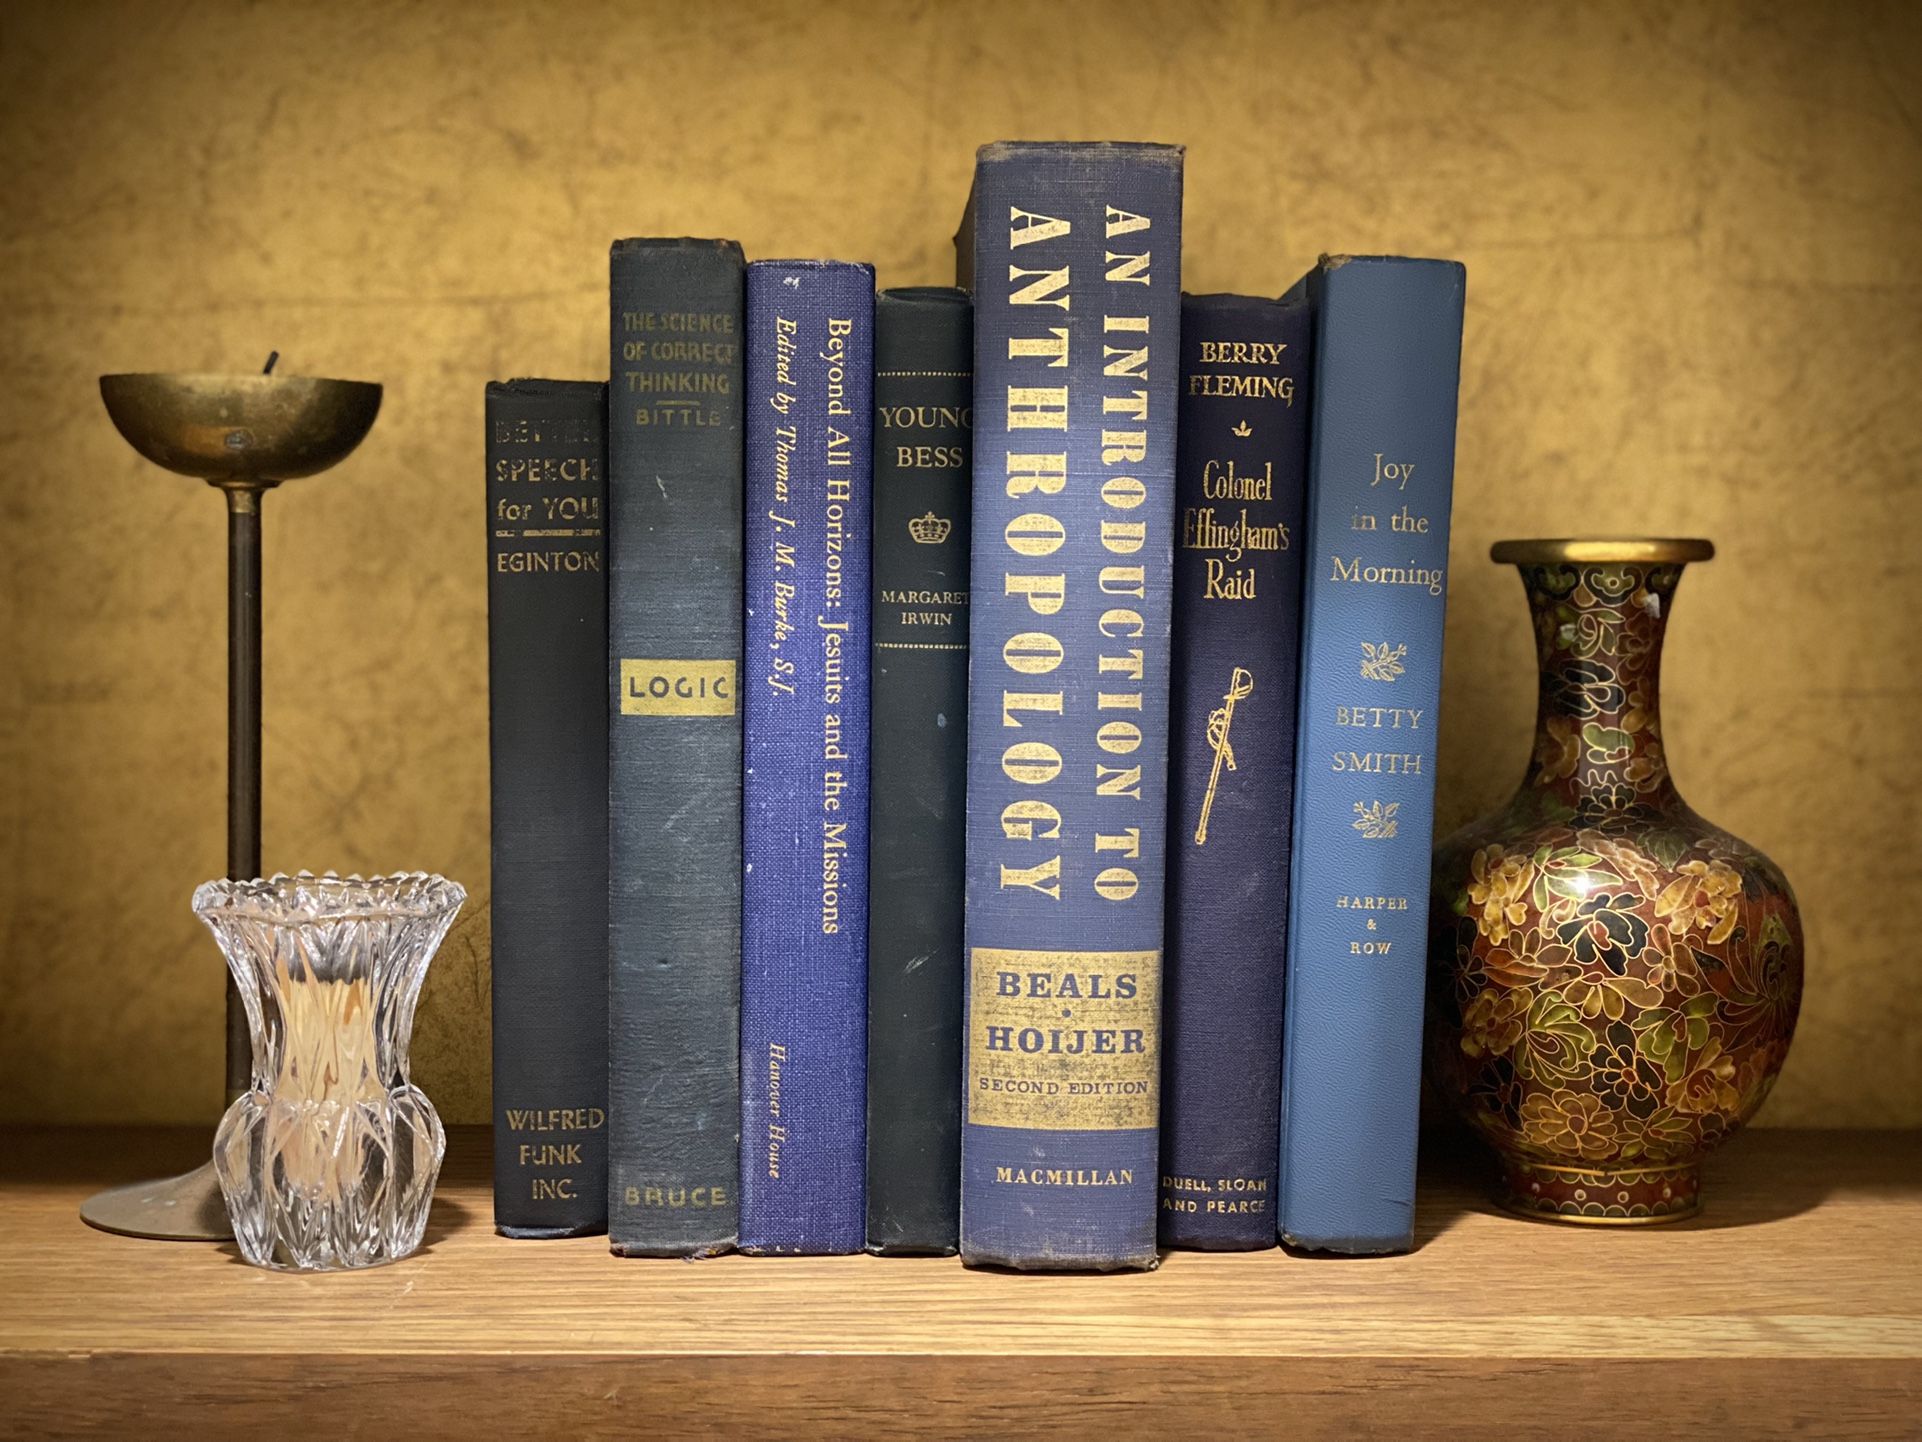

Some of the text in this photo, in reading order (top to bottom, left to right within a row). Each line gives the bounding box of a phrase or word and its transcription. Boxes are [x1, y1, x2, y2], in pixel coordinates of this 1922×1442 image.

[623, 312, 656, 331] THE
[623, 341, 646, 361] OF
[776, 316, 797, 386] Edited
[1200, 341, 1287, 365] BERRY
[625, 371, 730, 394] THINKING
[1189, 374, 1295, 408] FLEMING
[770, 392, 797, 415] by
[636, 408, 721, 426] BITTLE
[775, 425, 797, 504] Thomas
[896, 446, 963, 468] BESS
[495, 458, 600, 482] SPEECH
[1203, 459, 1273, 500] Colonel
[1370, 453, 1416, 490] Joy
[497, 497, 599, 521] for YOU
[1352, 504, 1429, 533] in the
[768, 510, 796, 533] J.
[1183, 507, 1290, 562] Effingham's
[497, 551, 600, 573] EGINTON
[774, 541, 796, 572] M.
[1000, 206, 1071, 901] ANTHROPOLOGY
[1094, 204, 1151, 900] AN INTRODUCTION TO
[1204, 558, 1256, 600] Raid
[1330, 555, 1443, 596] Morning
[769, 581, 795, 650] Burke,
[817, 318, 852, 935] Beyond All Horizons: Jesuits and the Missions
[901, 611, 952, 625] IRWIN
[629, 676, 729, 699] LOGIC
[1335, 707, 1424, 729] BETTY
[1331, 751, 1422, 775] SMITH
[1336, 895, 1408, 911] HARPER
[1366, 918, 1377, 931] &
[1350, 941, 1392, 955] ROW
[996, 971, 1138, 999] BEALS
[986, 1025, 1146, 1055] HOIJER
[979, 1077, 1149, 1095] SECOND EDITION
[506, 1108, 605, 1131] WILFRED
[768, 1042, 786, 1179] Hanover House
[519, 1144, 582, 1166] FUNK
[996, 1166, 1134, 1185] MACMILLAN
[1162, 1176, 1267, 1193] DUELL, SLOAN
[532, 1178, 578, 1200] INC.
[624, 1186, 726, 1208] BRUCE
[1163, 1197, 1266, 1214] AND PEARCE
